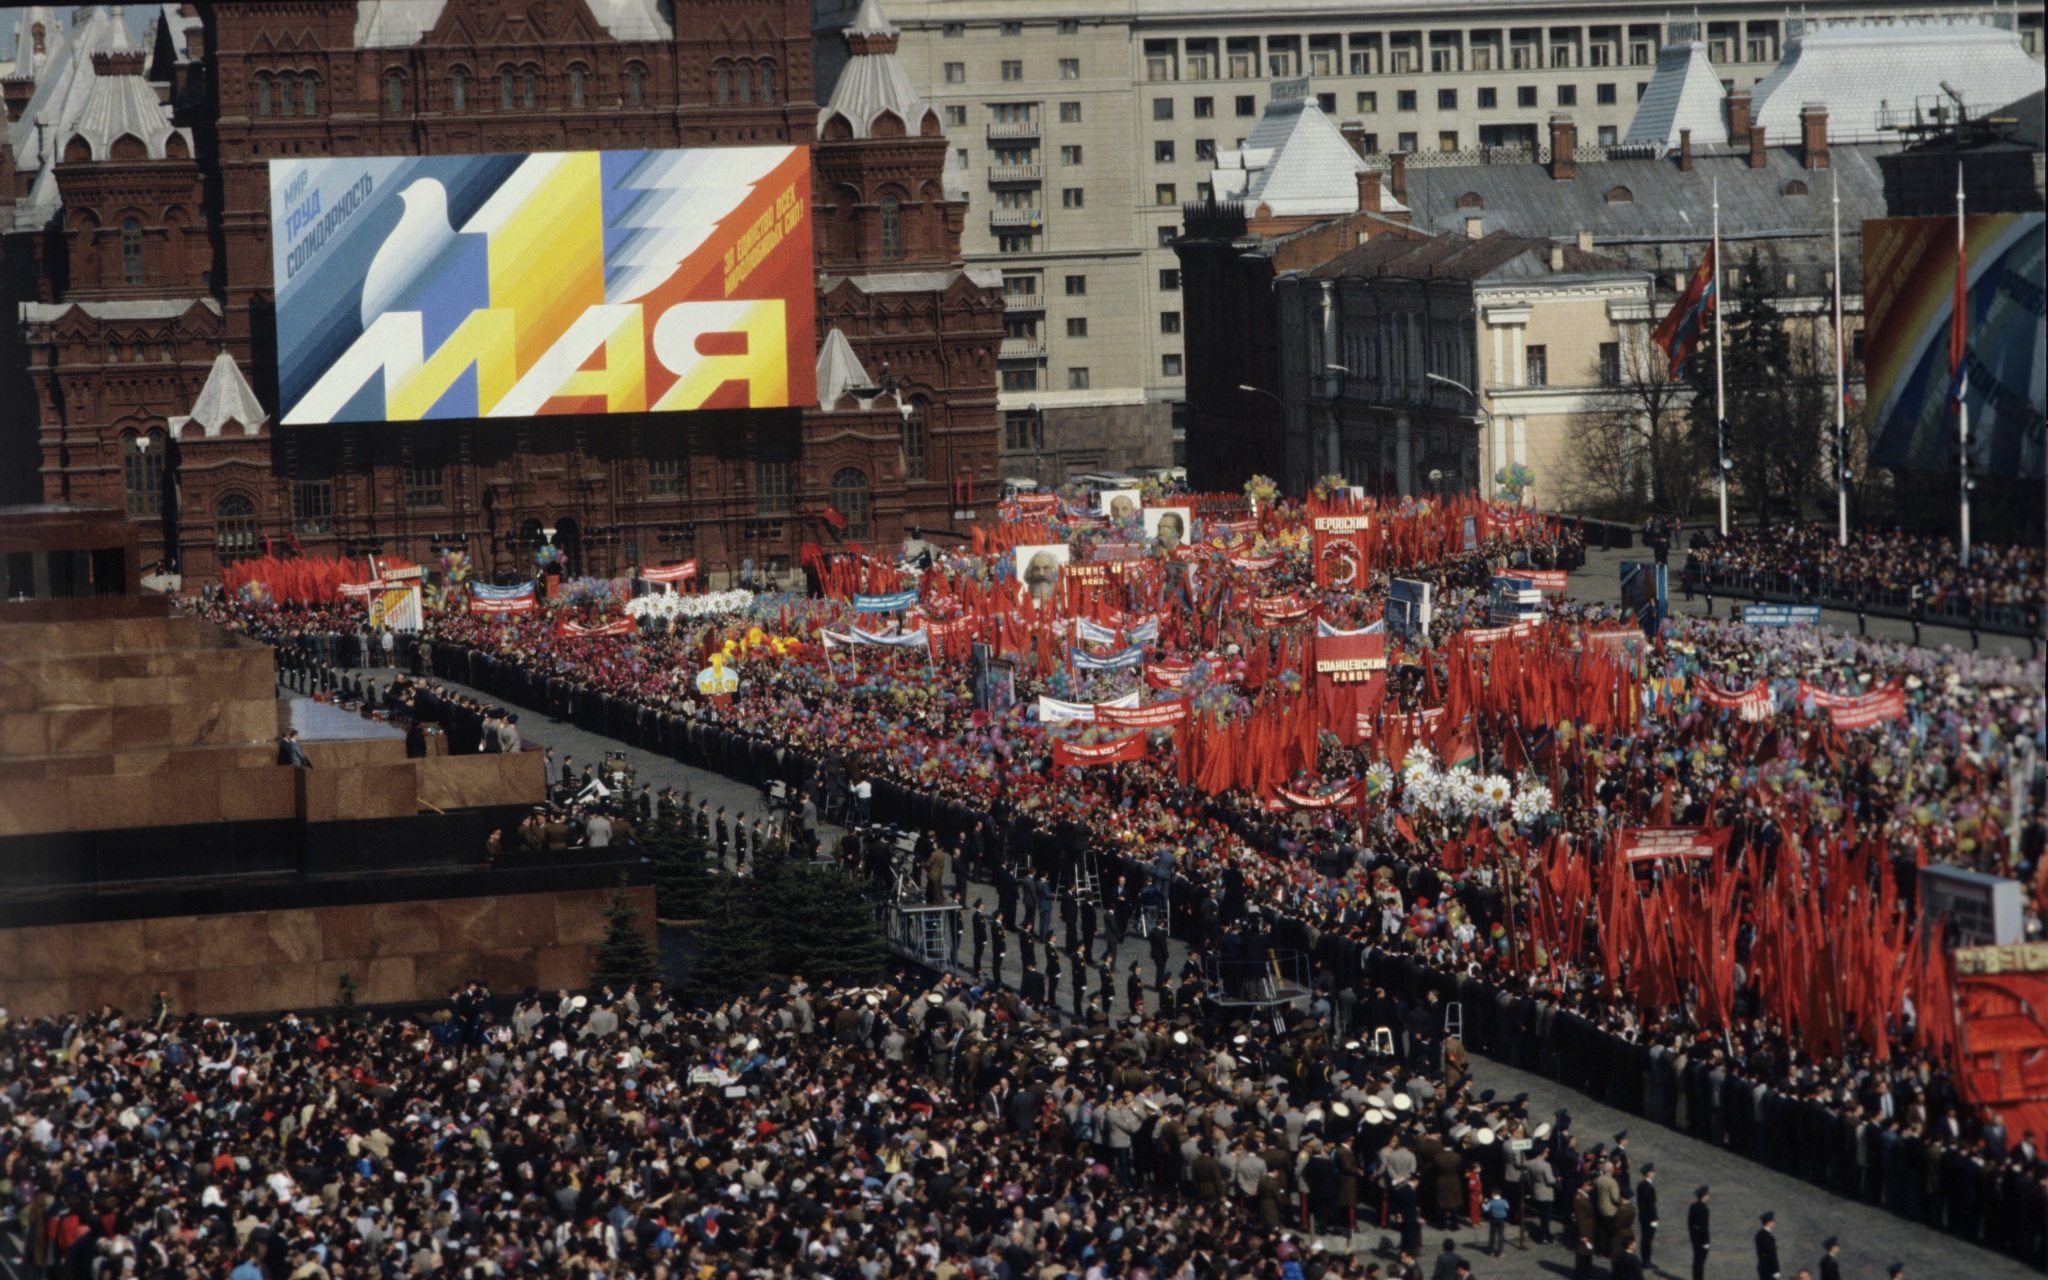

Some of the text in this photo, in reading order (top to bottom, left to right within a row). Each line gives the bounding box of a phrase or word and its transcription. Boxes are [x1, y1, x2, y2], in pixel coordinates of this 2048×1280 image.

[284, 169, 308, 209] МИР
[285, 187, 321, 242] ТРУД
[287, 171, 373, 280] СОЛИДАРНОСТЬ
[737, 205, 774, 262] ЕДИНСТВО
[776, 182, 796, 221] ВСЕХ
[724, 219, 783, 298] МИРОЛЮБИВЫХ
[280, 299, 789, 426] МАЯ
[1315, 515, 1369, 531] ПЕРОВСКИЙ
[708, 653, 722, 680] 1
[1317, 657, 1387, 672] СОЛНЦЕВСКИЙ
[1333, 670, 1370, 683] РАЙОН
[701, 679, 738, 695] МАЯ
